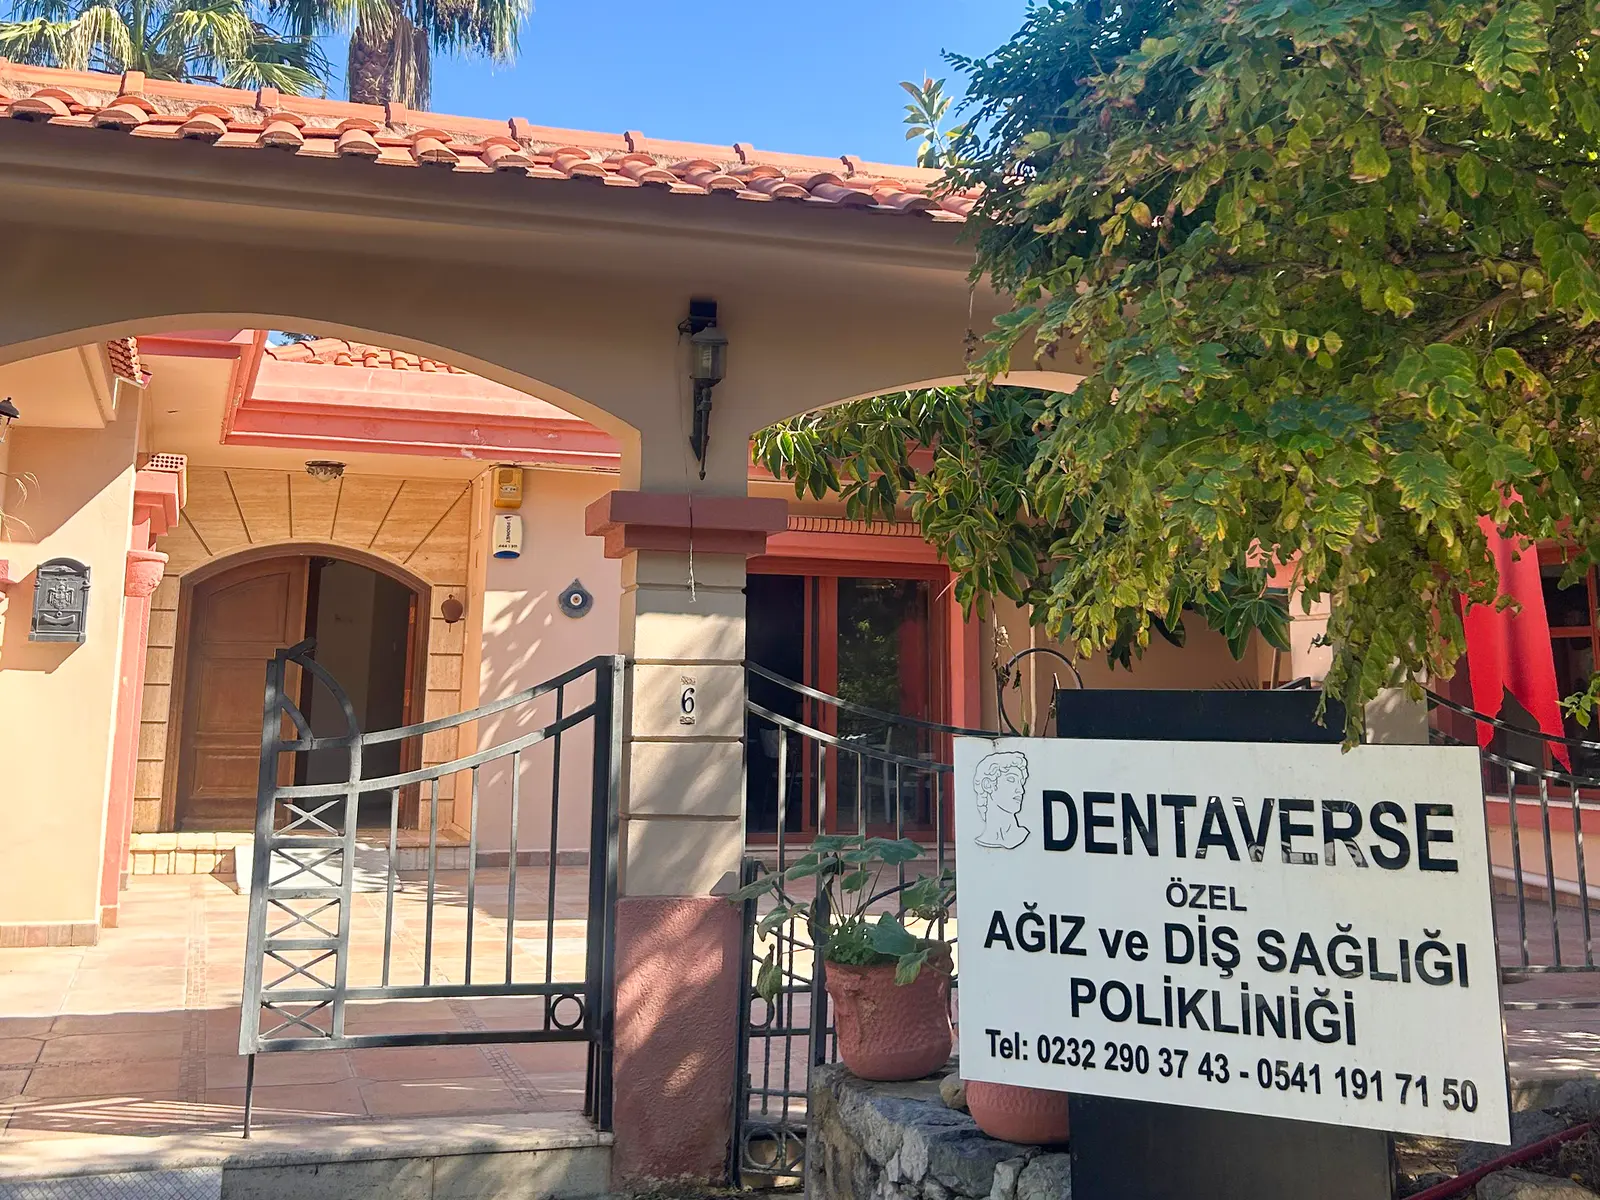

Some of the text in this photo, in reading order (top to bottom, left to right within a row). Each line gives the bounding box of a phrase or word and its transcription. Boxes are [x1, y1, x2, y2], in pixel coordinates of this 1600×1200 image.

[682, 687, 695, 714] 6
[1042, 790, 1459, 872] DENTAVERSE
[1166, 877, 1247, 912] ÖZEL
[984, 901, 1470, 988] AĞIZ ve DİŞ SAĞLIĞI
[1071, 975, 1357, 1046] POLİKLİNİĞİ
[985, 1028, 1478, 1113] Tel: 0232 290 37 43 - 0541 191 71 50
